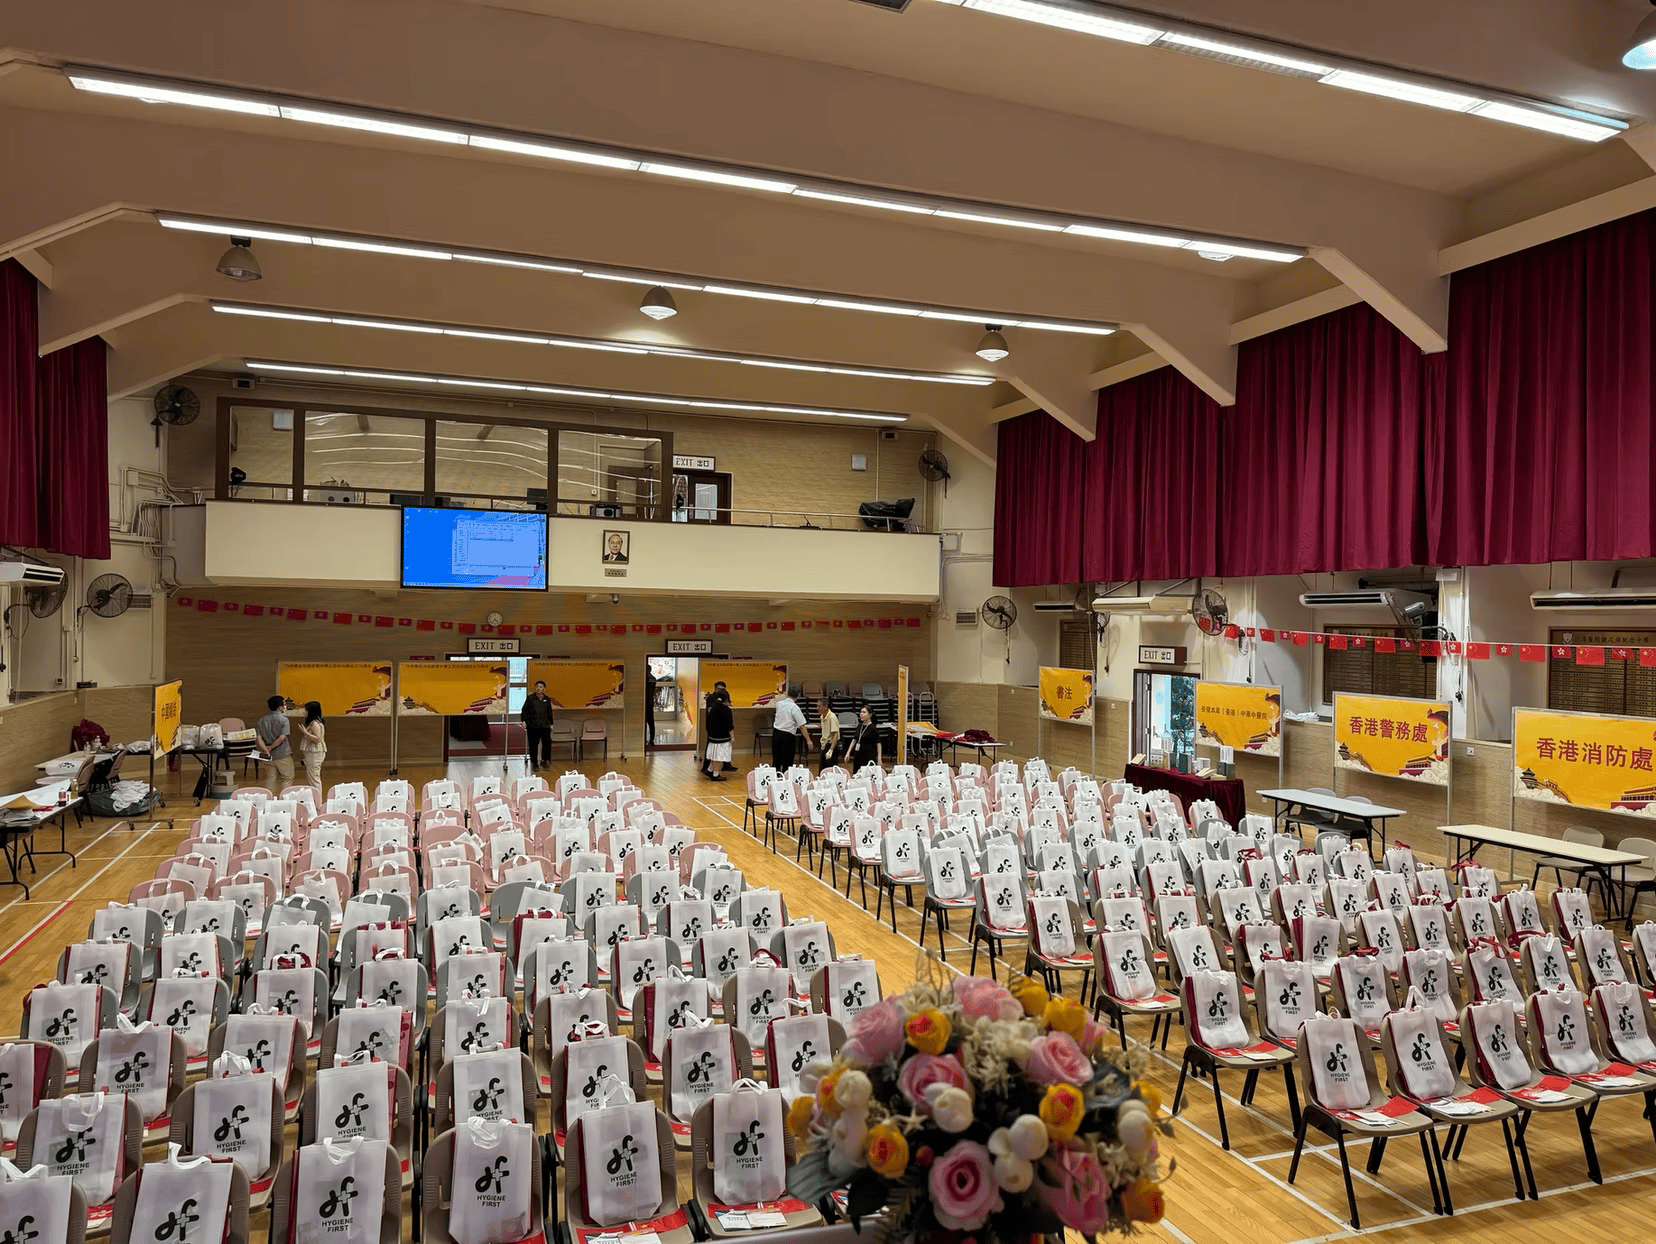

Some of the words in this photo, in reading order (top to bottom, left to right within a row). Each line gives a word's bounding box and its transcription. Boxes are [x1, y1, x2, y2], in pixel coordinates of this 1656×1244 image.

[676, 458, 693, 466] EXIT
[475, 642, 495, 650] EXIT
[499, 642, 513, 650] 出口
[673, 643, 690, 651] EXIT
[694, 643, 707, 651] 出口
[1144, 650, 1158, 659] EXIT
[1161, 651, 1172, 660] 出口
[1056, 685, 1073, 700] 書法
[1349, 716, 1429, 743] 香港警務處
[1536, 737, 1654, 772] 香港消防處
[116, 1082, 145, 1090] HYGIENE
[689, 1082, 715, 1090] HYGIENE
[476, 1110, 504, 1118] HYGIENE
[338, 1126, 367, 1135] HYGIENE
[216, 1140, 247, 1149] HYGIENE
[221, 1146, 241, 1154] FIRST
[736, 1156, 763, 1164] HYGIENE
[57, 1162, 90, 1171] HYGIENE
[610, 1172, 638, 1183] HYGIENE
[616, 1179, 635, 1188] FIRST
[482, 1200, 501, 1208] FIRST
[321, 1218, 354, 1227] HYGIENE
[327, 1225, 349, 1233] FIRST
